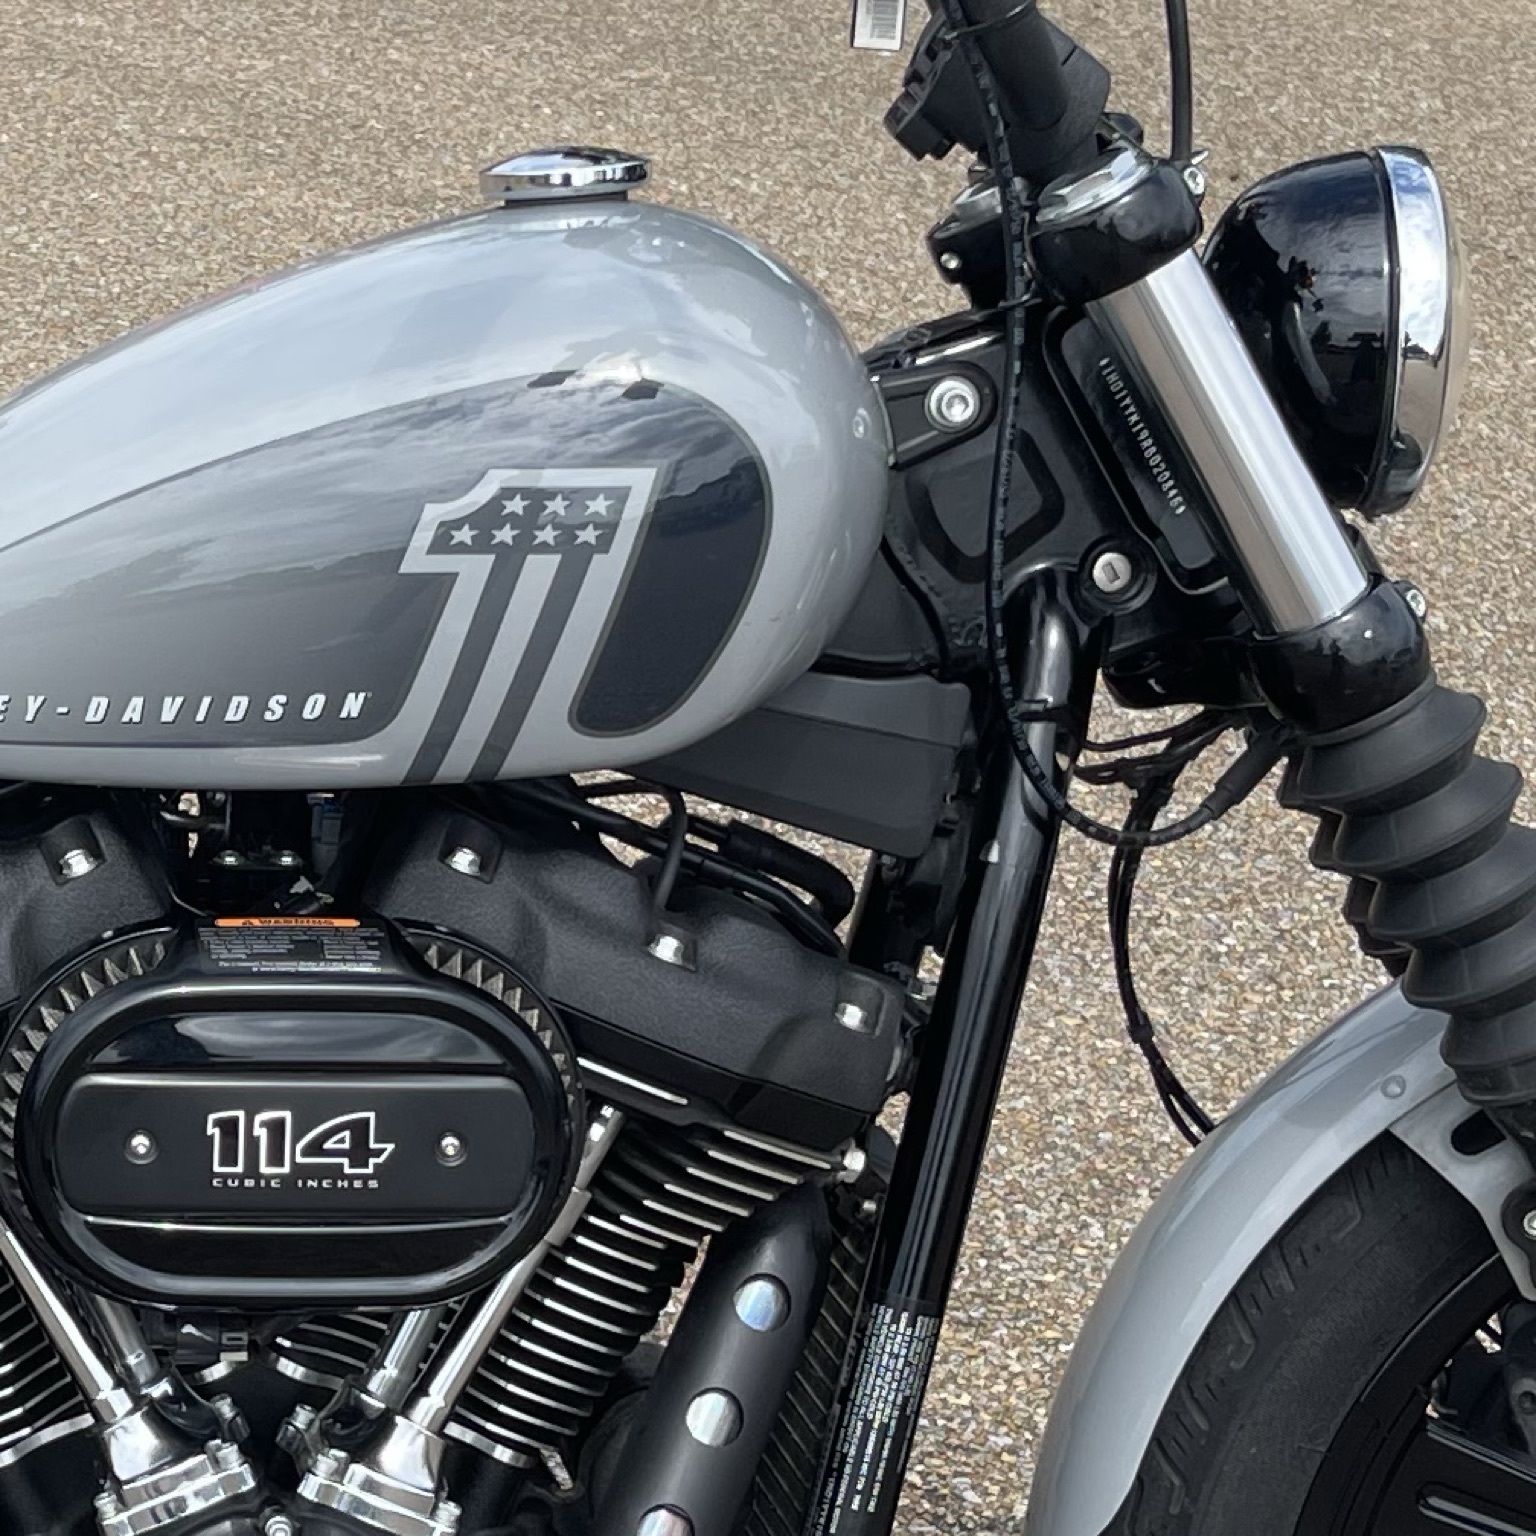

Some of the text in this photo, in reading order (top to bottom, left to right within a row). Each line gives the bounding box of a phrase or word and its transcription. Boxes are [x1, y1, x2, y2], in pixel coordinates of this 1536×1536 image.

[206, 1110, 396, 1174] 114
[211, 1177, 379, 1189] CUBIC INCHES
